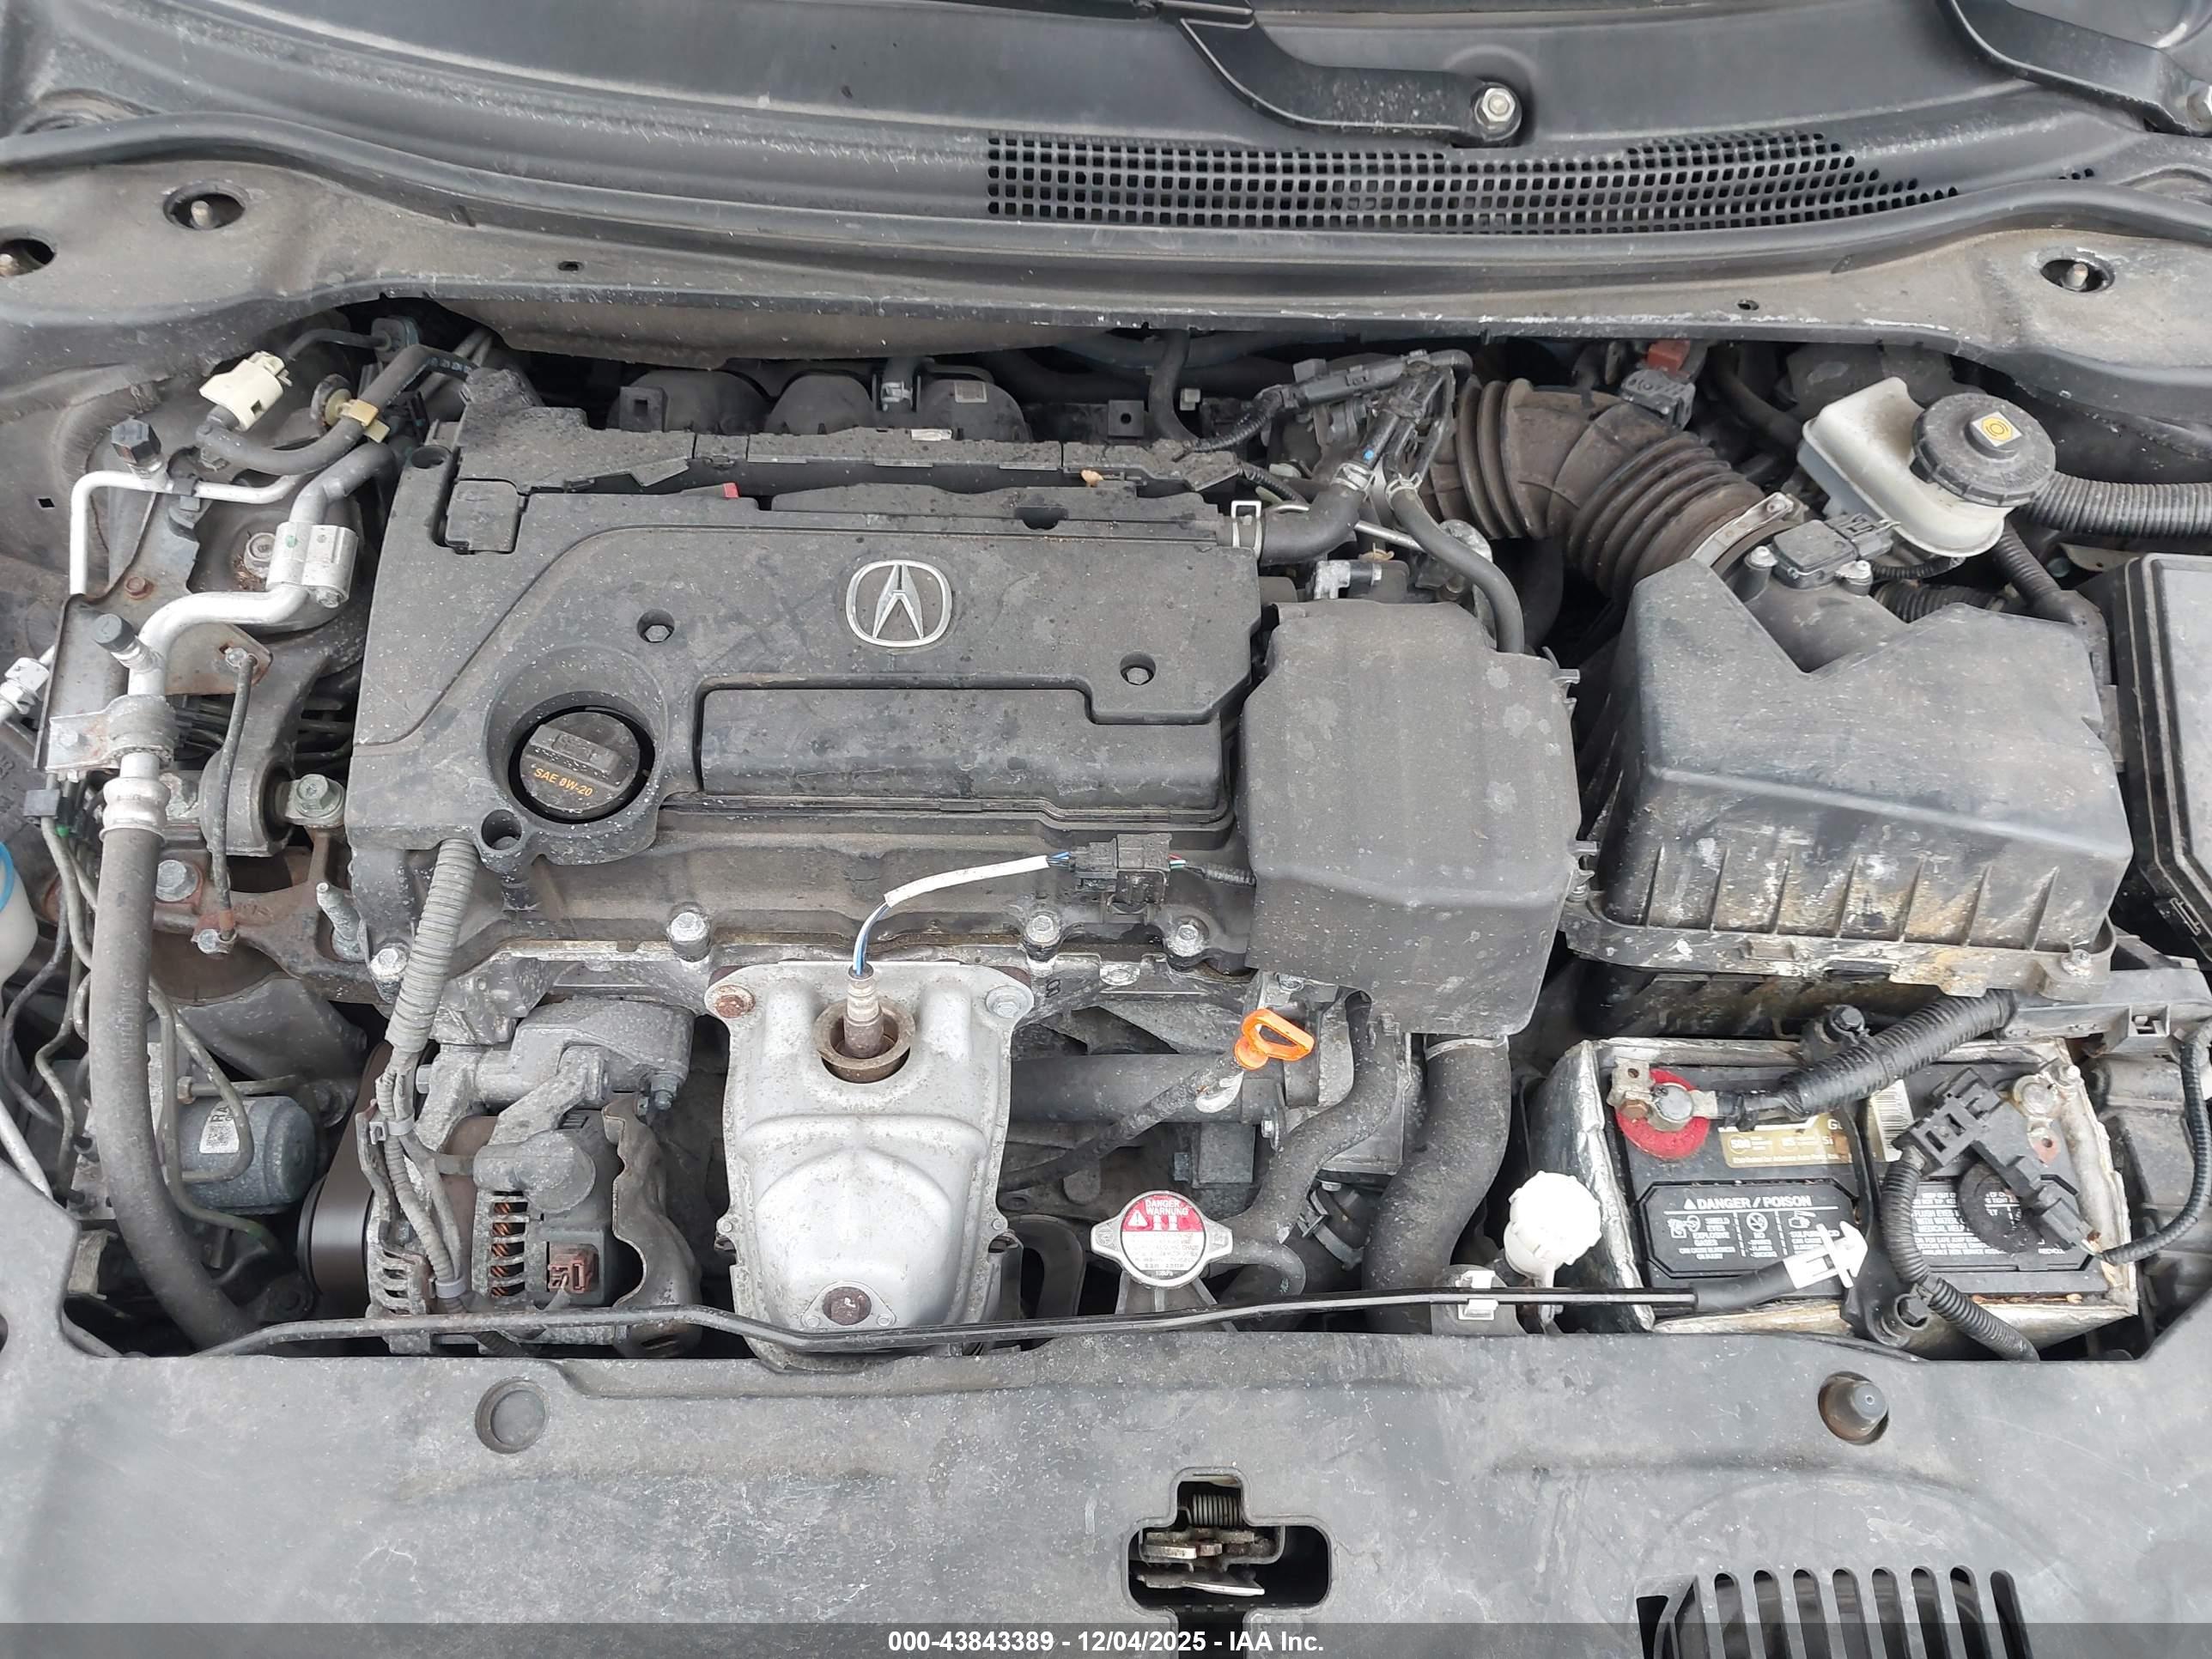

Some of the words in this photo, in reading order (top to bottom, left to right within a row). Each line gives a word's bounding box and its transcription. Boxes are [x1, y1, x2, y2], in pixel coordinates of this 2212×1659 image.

[534, 768, 558, 784] SAE
[559, 777, 593, 797] 0W-20
[1697, 1197, 1751, 1210] DANGER
[1764, 1195, 1812, 1207] POISON
[1146, 1207, 1189, 1216] WARNUNG
